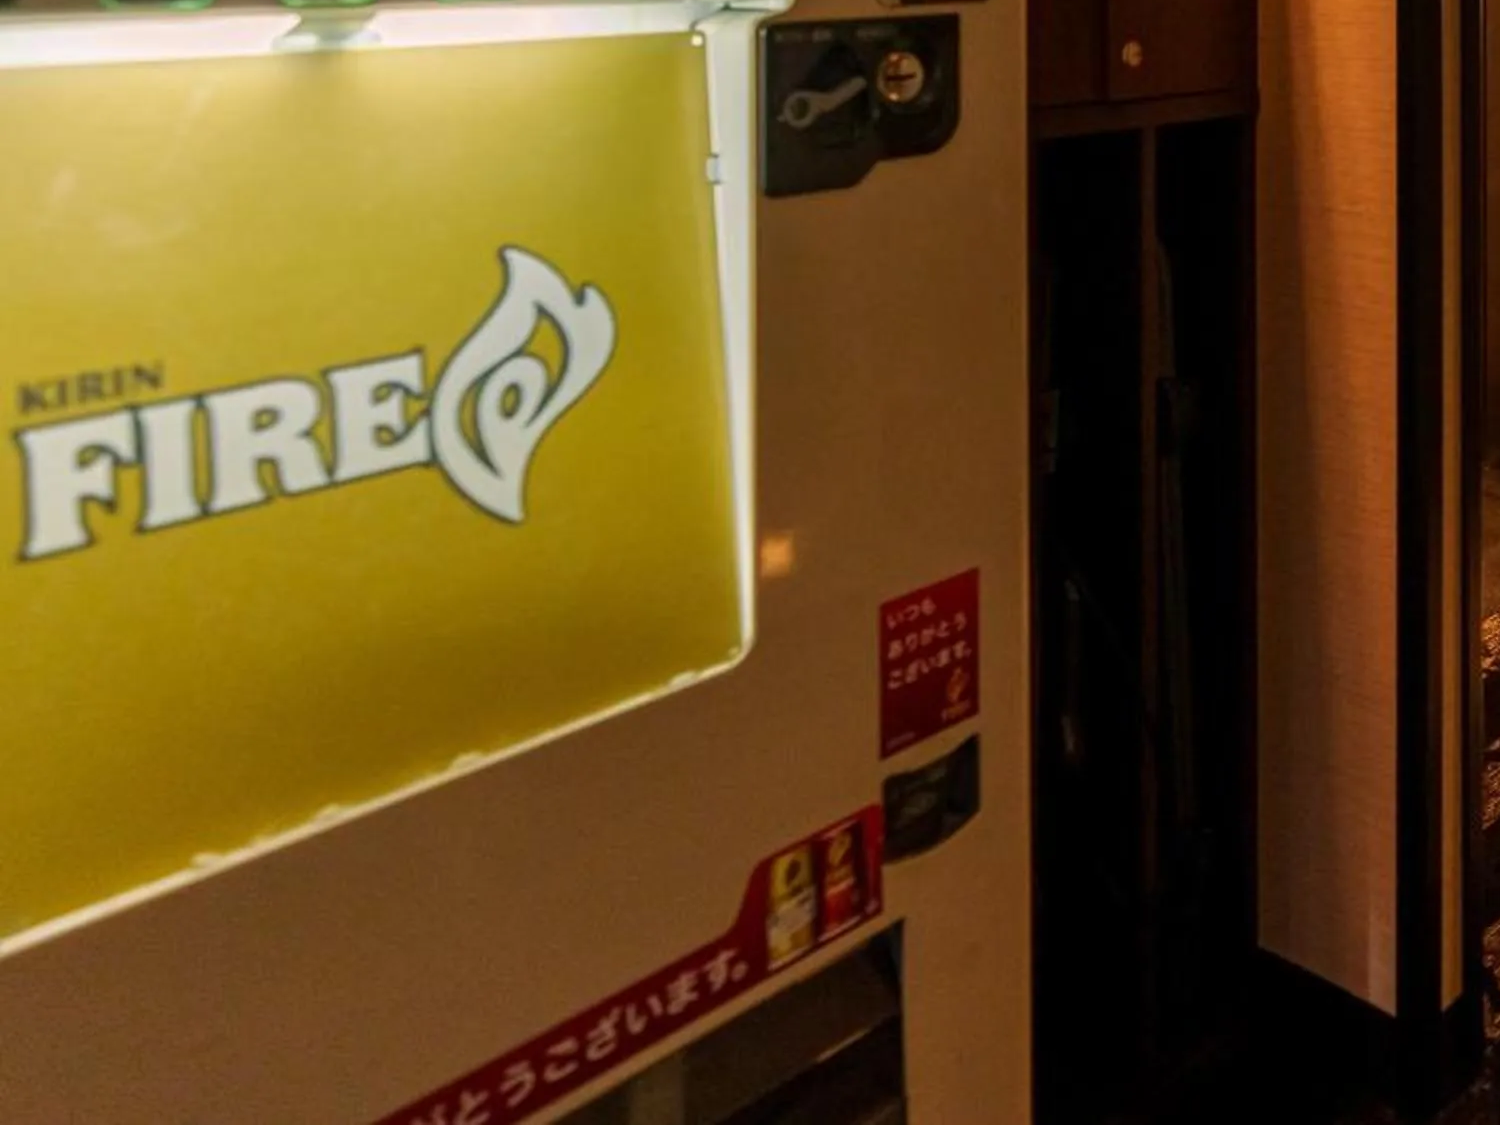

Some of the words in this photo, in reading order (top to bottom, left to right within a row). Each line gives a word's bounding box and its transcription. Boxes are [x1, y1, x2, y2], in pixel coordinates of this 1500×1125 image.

[17, 361, 165, 415] KIRIN
[13, 346, 436, 563] FIRE
[888, 597, 936, 629] いつも
[888, 612, 967, 660] ありがとう
